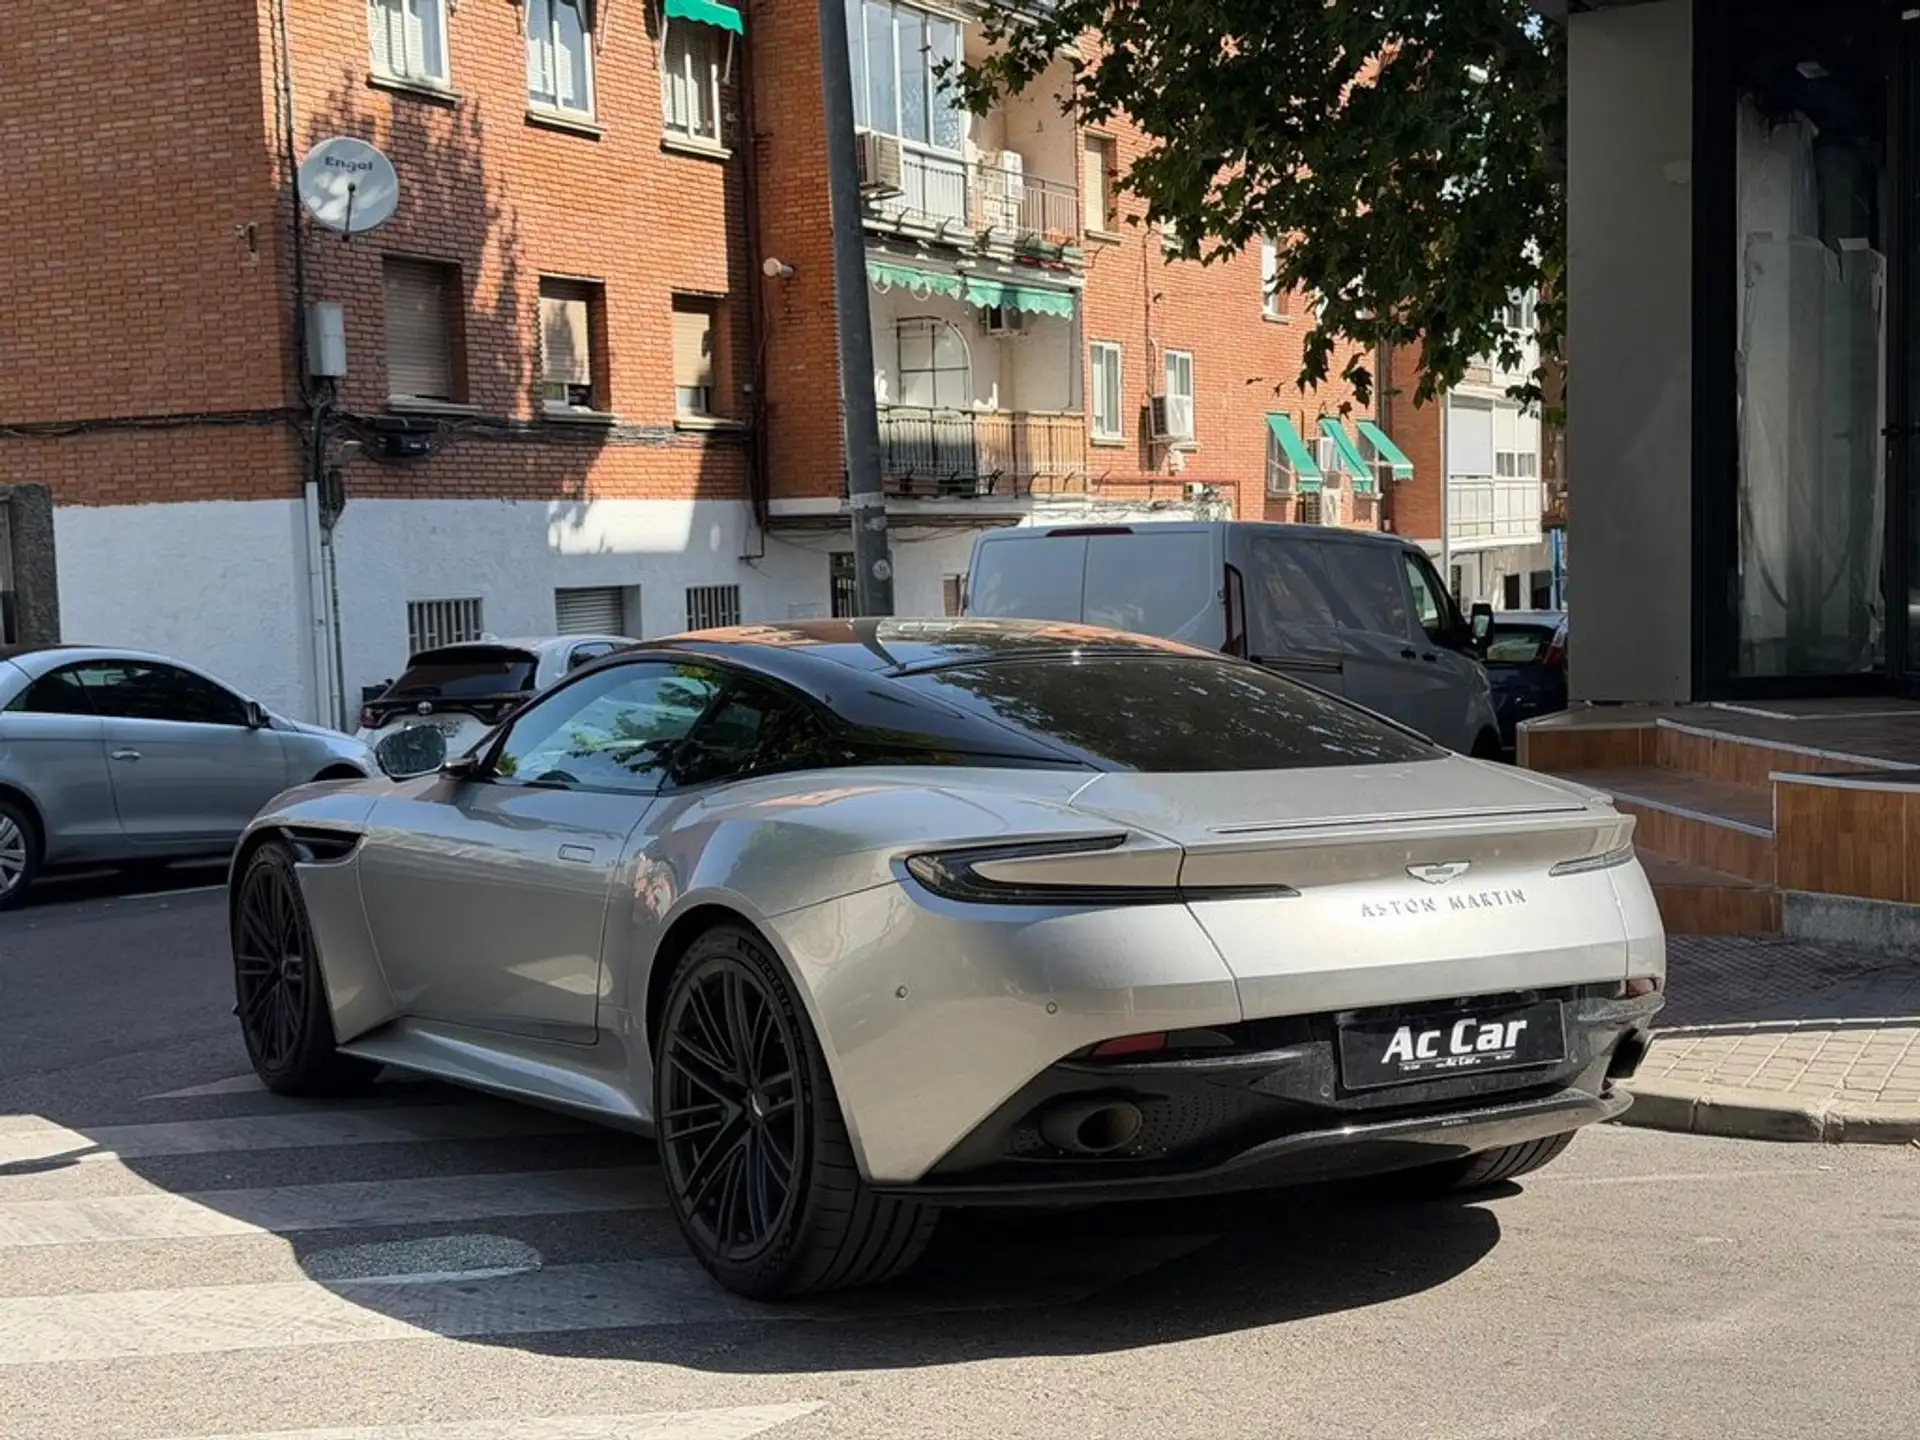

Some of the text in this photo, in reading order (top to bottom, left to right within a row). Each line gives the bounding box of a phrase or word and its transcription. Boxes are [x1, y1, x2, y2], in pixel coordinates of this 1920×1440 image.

[1362, 888, 1527, 918] ASTON MARTIN
[1381, 1018, 1528, 1064] Ac Car
